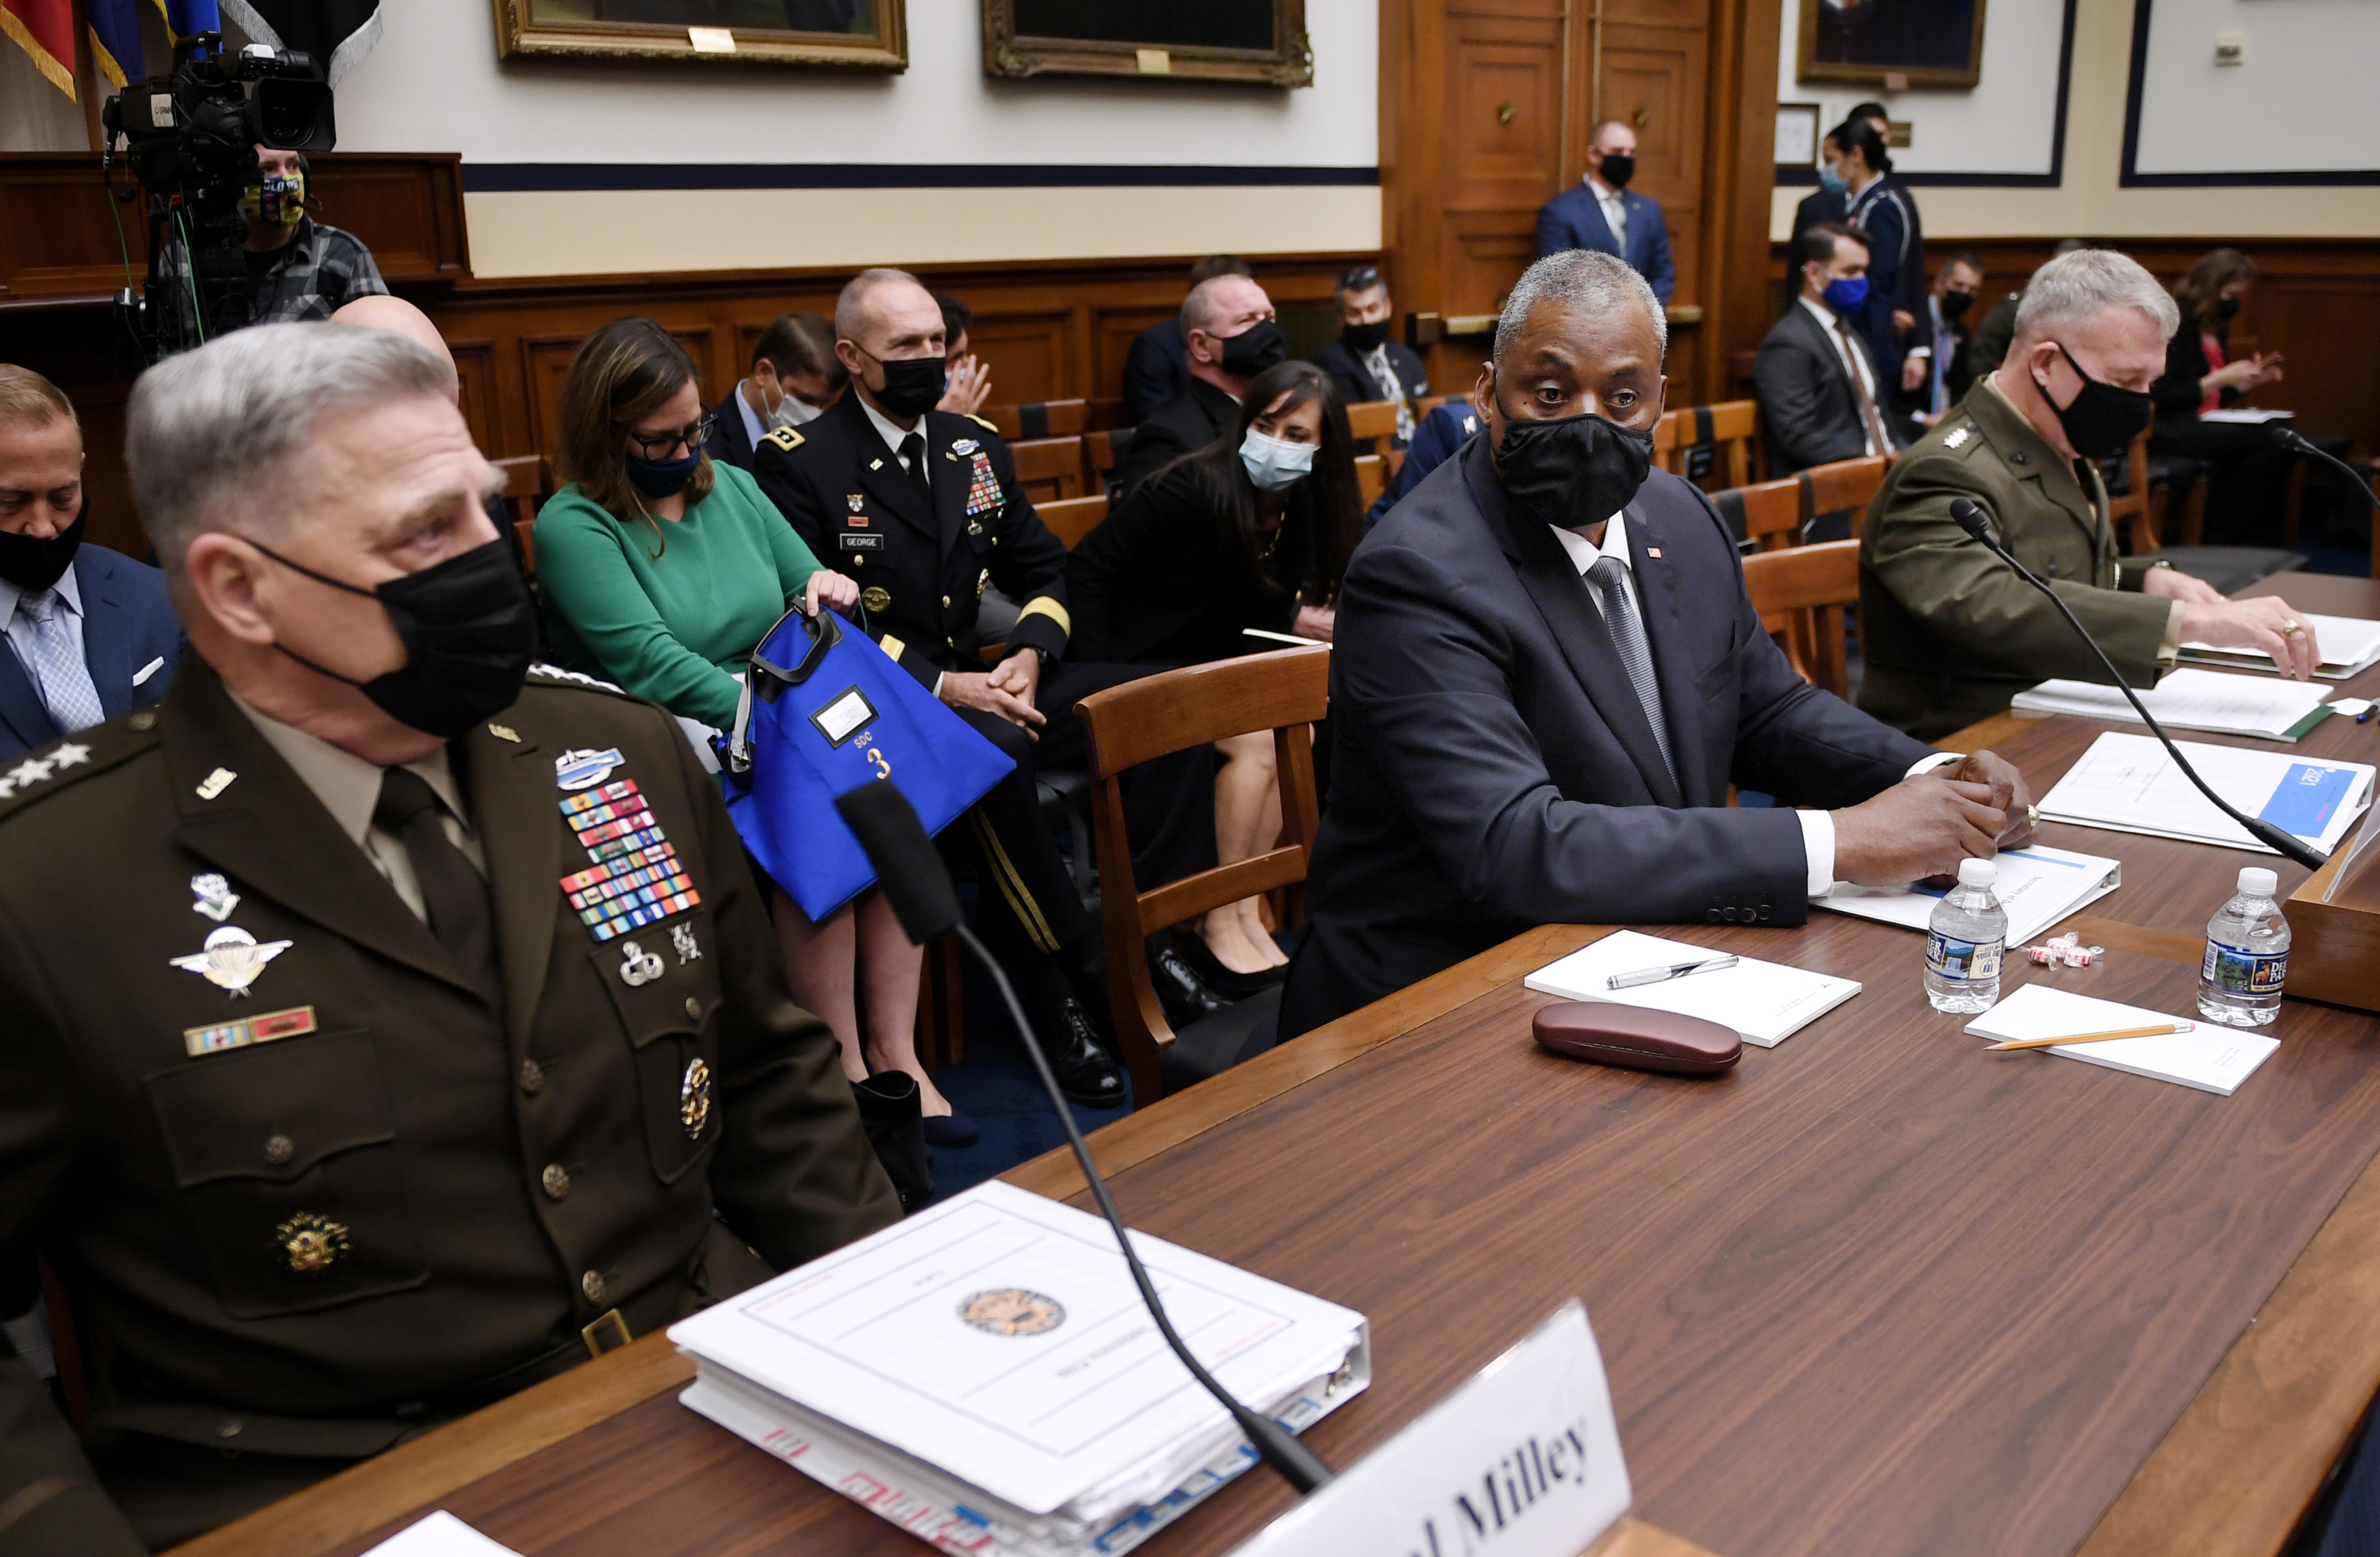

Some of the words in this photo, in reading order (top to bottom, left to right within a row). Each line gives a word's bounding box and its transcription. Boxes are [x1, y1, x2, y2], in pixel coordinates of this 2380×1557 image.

[847, 538, 876, 547] GEORGE
[854, 731, 873, 749] SDC
[867, 748, 891, 779] 3
[1927, 936, 1942, 953] EER
[1975, 951, 1992, 961] YOUR
[1458, 1417, 1587, 1556] Milley
